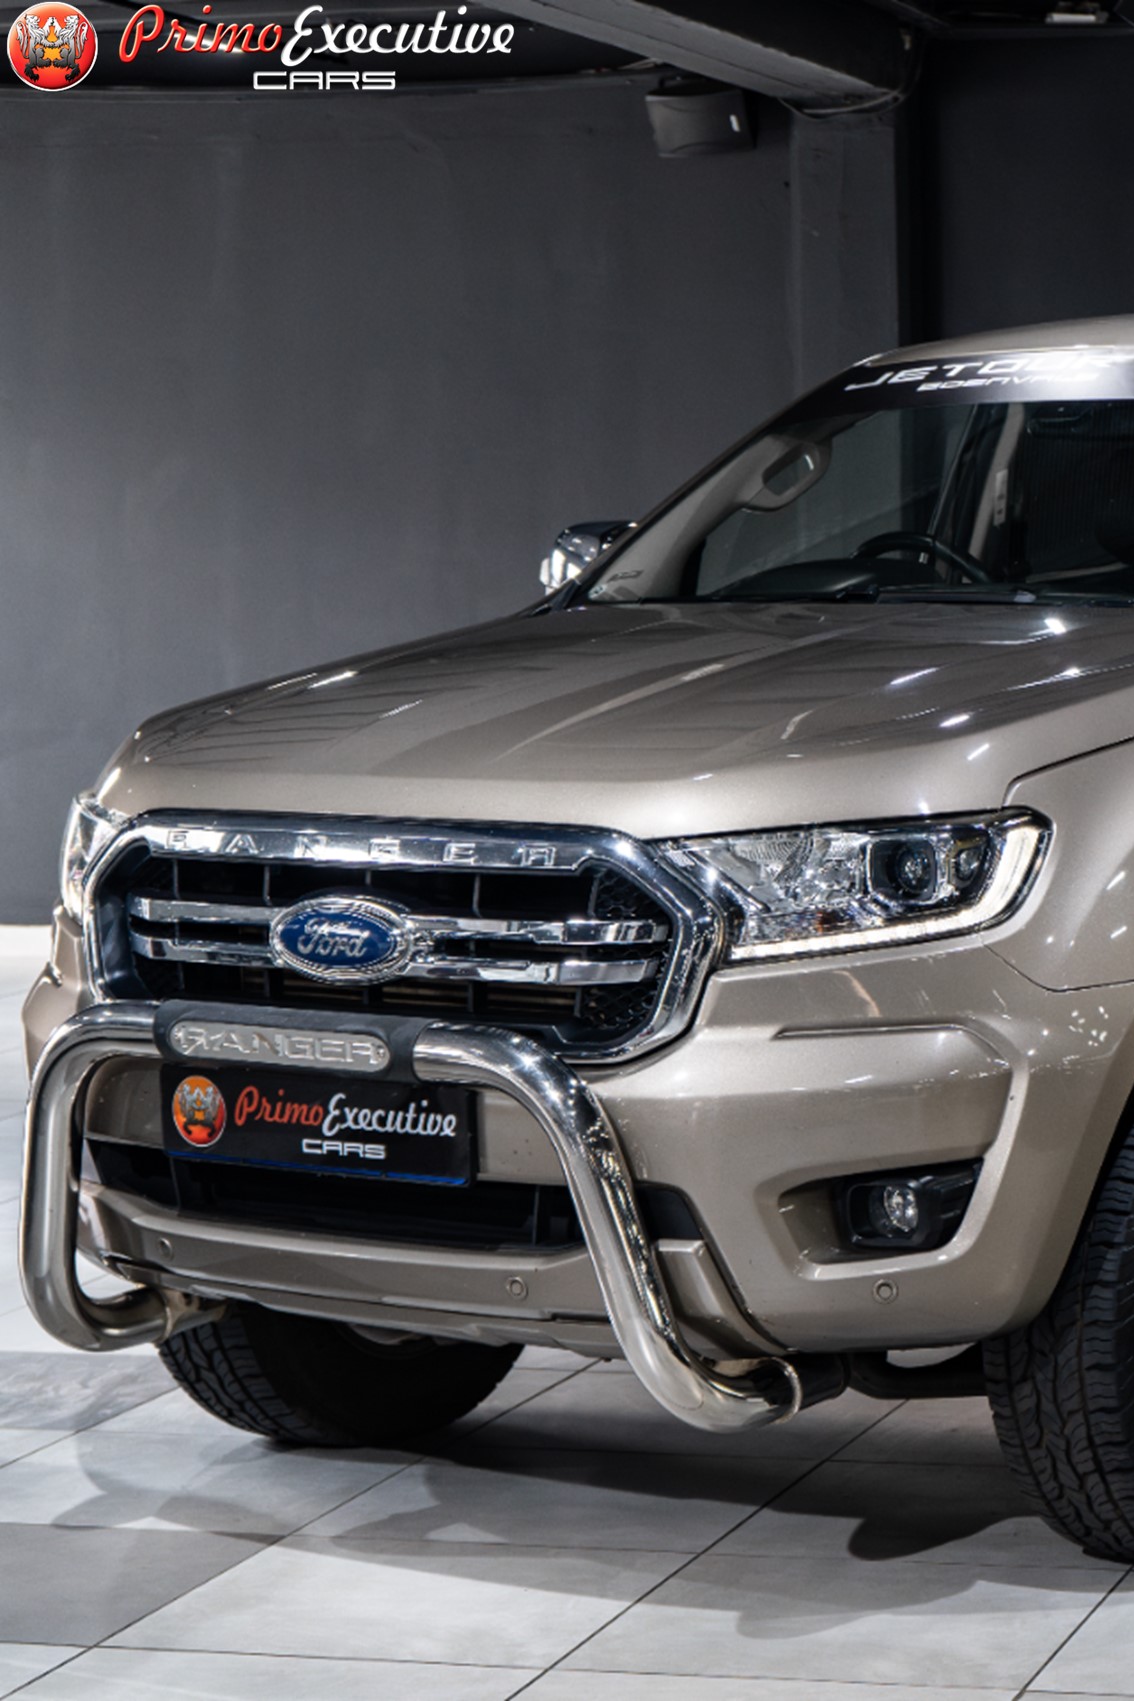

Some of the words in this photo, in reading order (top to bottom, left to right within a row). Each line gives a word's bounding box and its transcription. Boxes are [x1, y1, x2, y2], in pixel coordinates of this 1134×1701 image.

[166, 829, 557, 867] RANGER
[297, 918, 371, 958] Ford
[176, 1026, 379, 1065] RANGER
[234, 1085, 323, 1126] Primo
[322, 1093, 457, 1137] Executive
[302, 1138, 386, 1160] CARS
